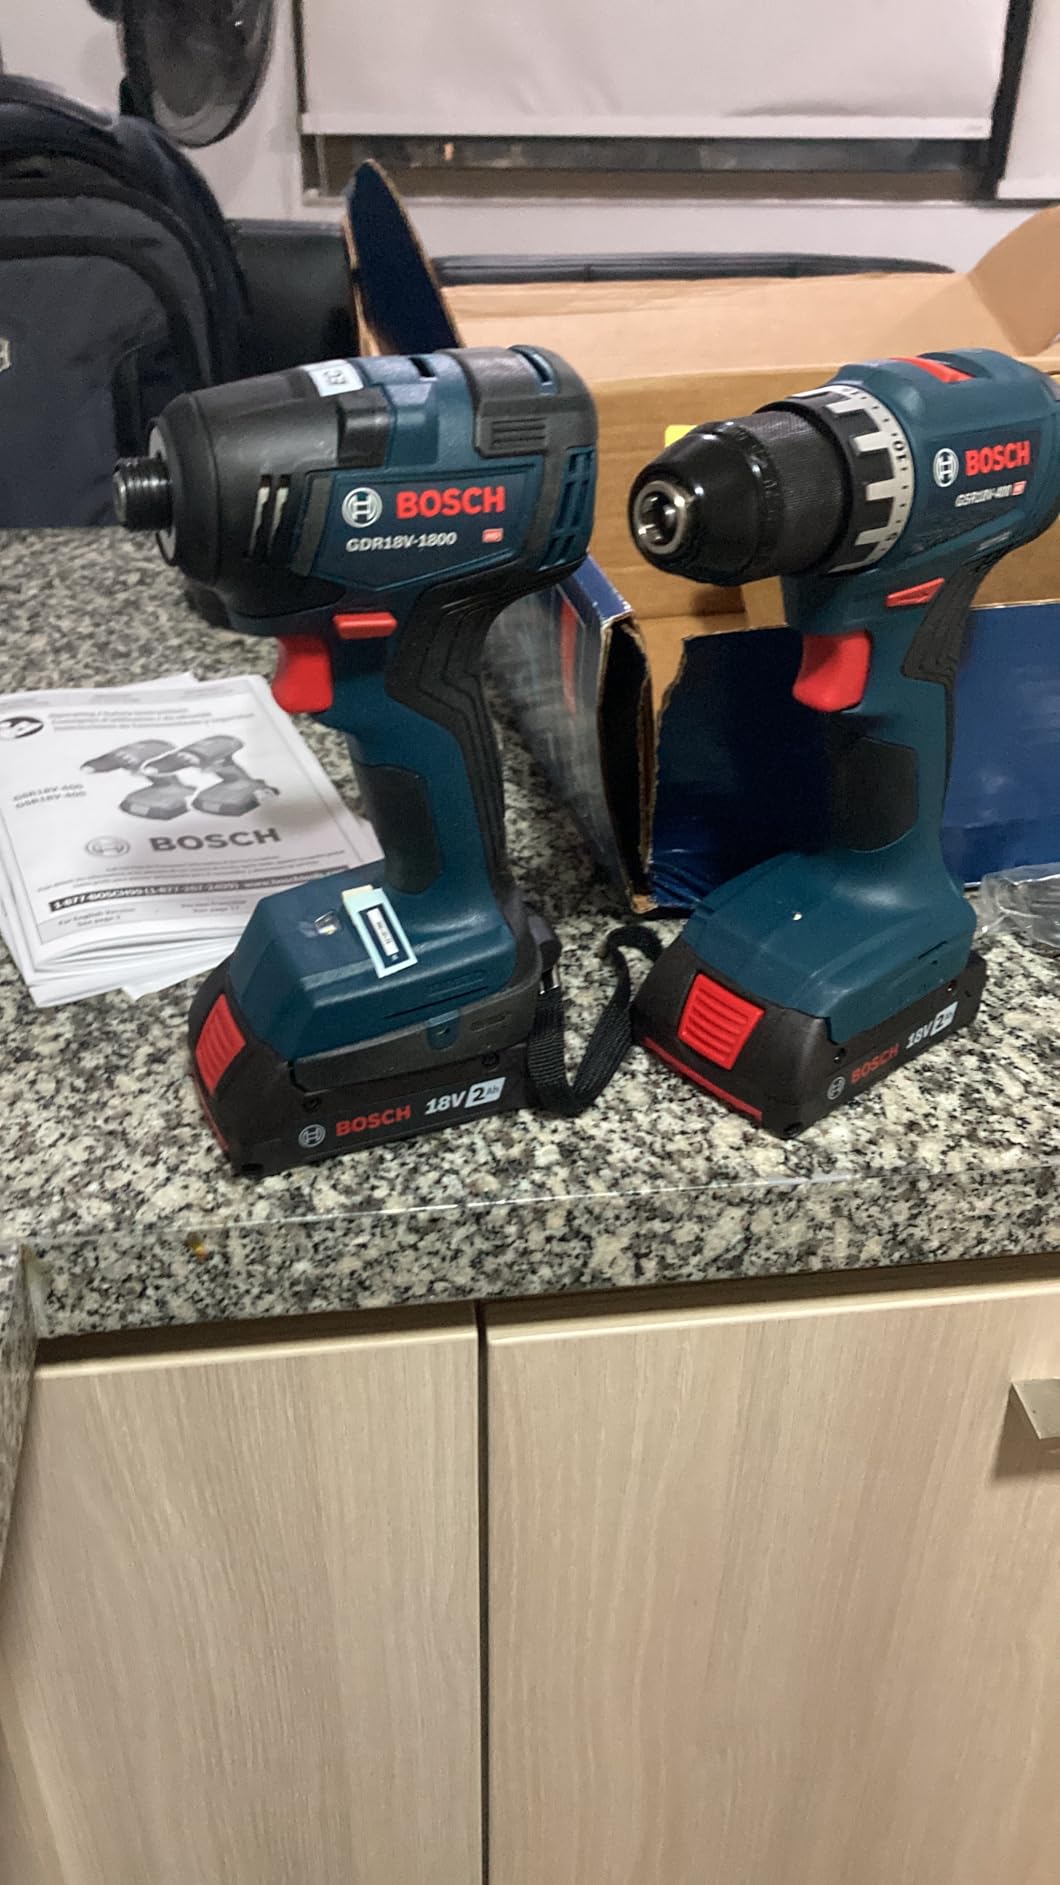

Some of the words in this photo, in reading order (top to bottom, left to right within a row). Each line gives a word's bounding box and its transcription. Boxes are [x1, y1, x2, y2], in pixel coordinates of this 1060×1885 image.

[964, 440, 1031, 476] BOSCH
[395, 486, 505, 519] BOSCH
[346, 531, 457, 553] GDR18V-1800
[149, 827, 282, 851] BOSCH
[851, 1043, 900, 1084] BOSCH
[905, 1021, 934, 1050] 18V
[335, 1104, 412, 1137] BOSCH
[424, 1090, 467, 1116] 18V
